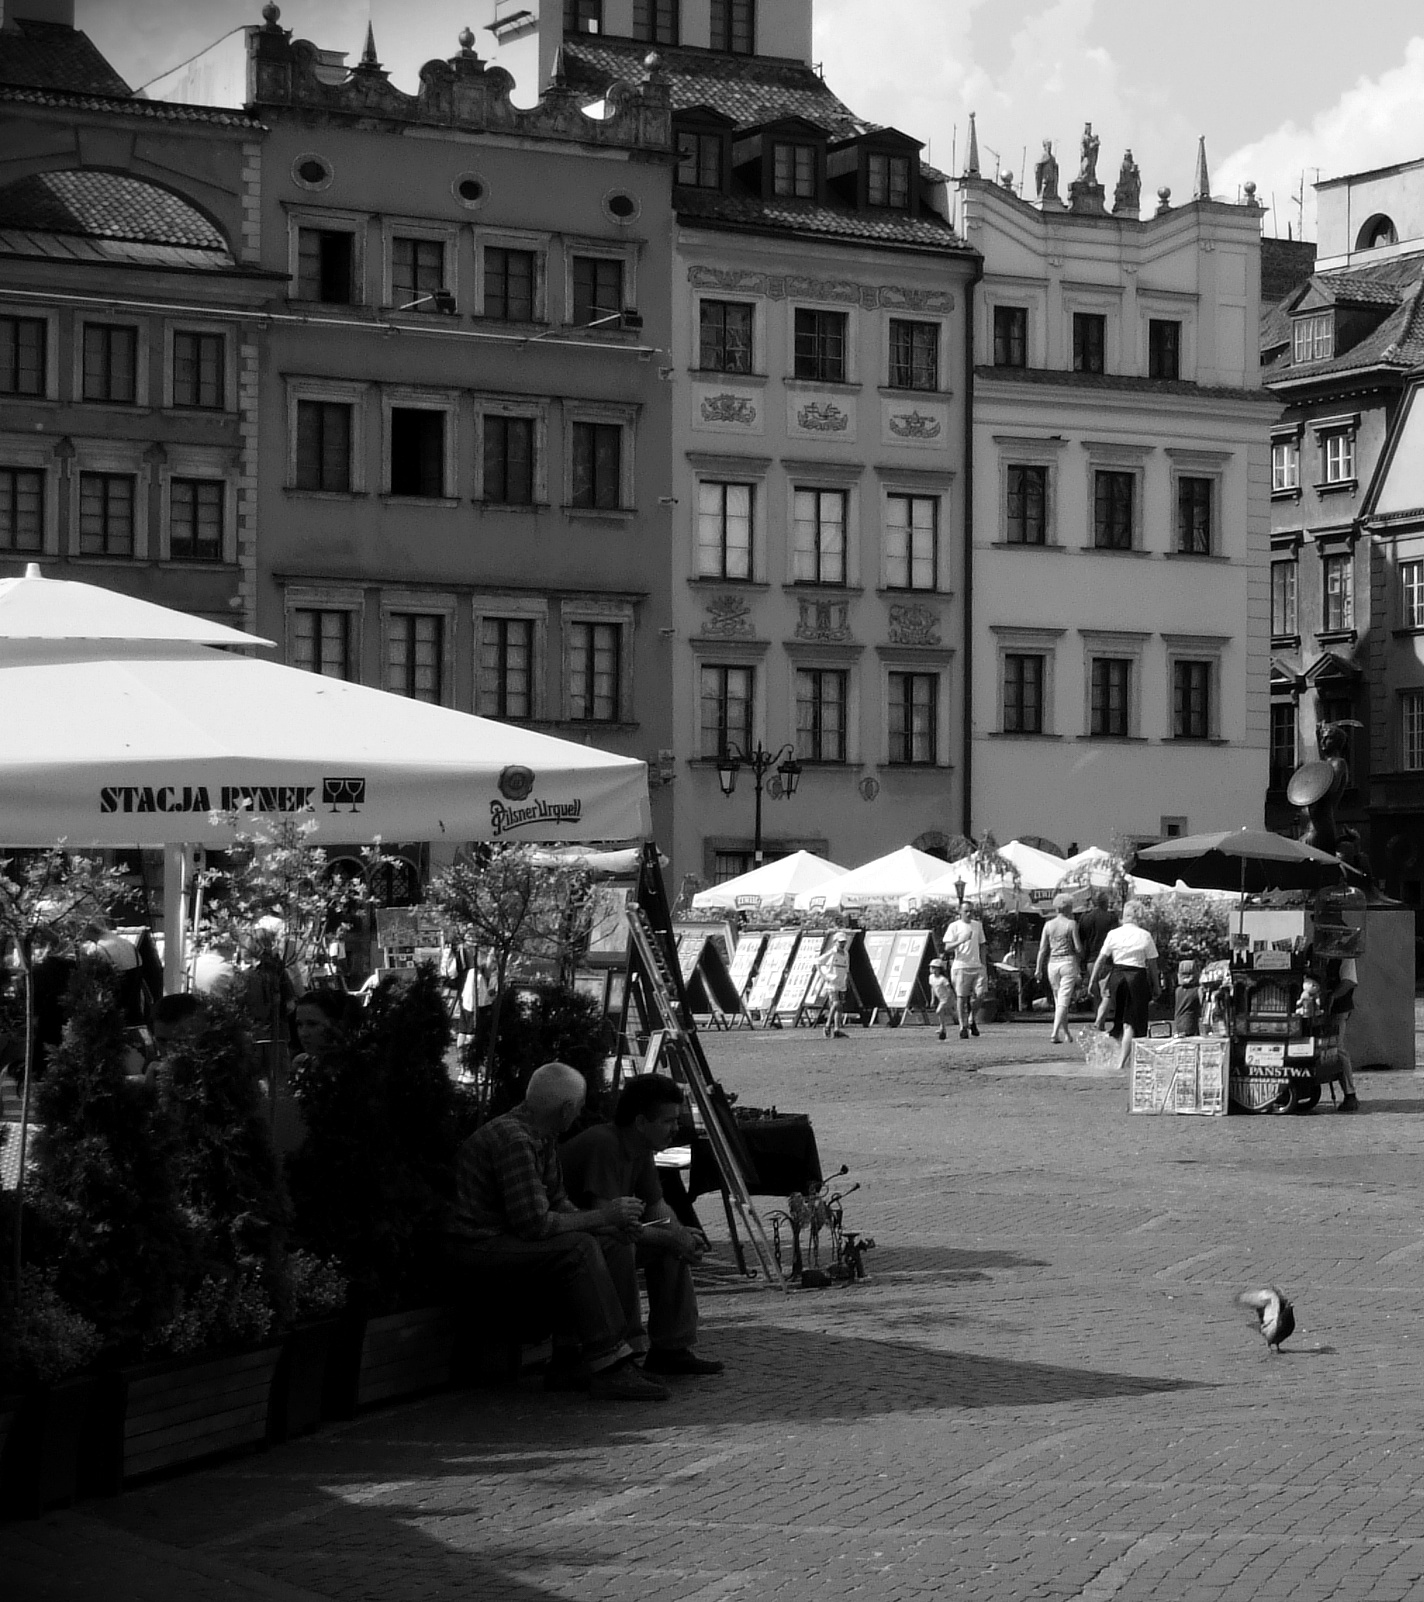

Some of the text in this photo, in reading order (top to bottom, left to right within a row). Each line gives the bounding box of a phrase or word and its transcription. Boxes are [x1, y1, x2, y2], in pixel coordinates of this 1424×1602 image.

[100, 786, 316, 812] STACJA RYNEK
[489, 798, 581, 836] Pilsner Urquell
